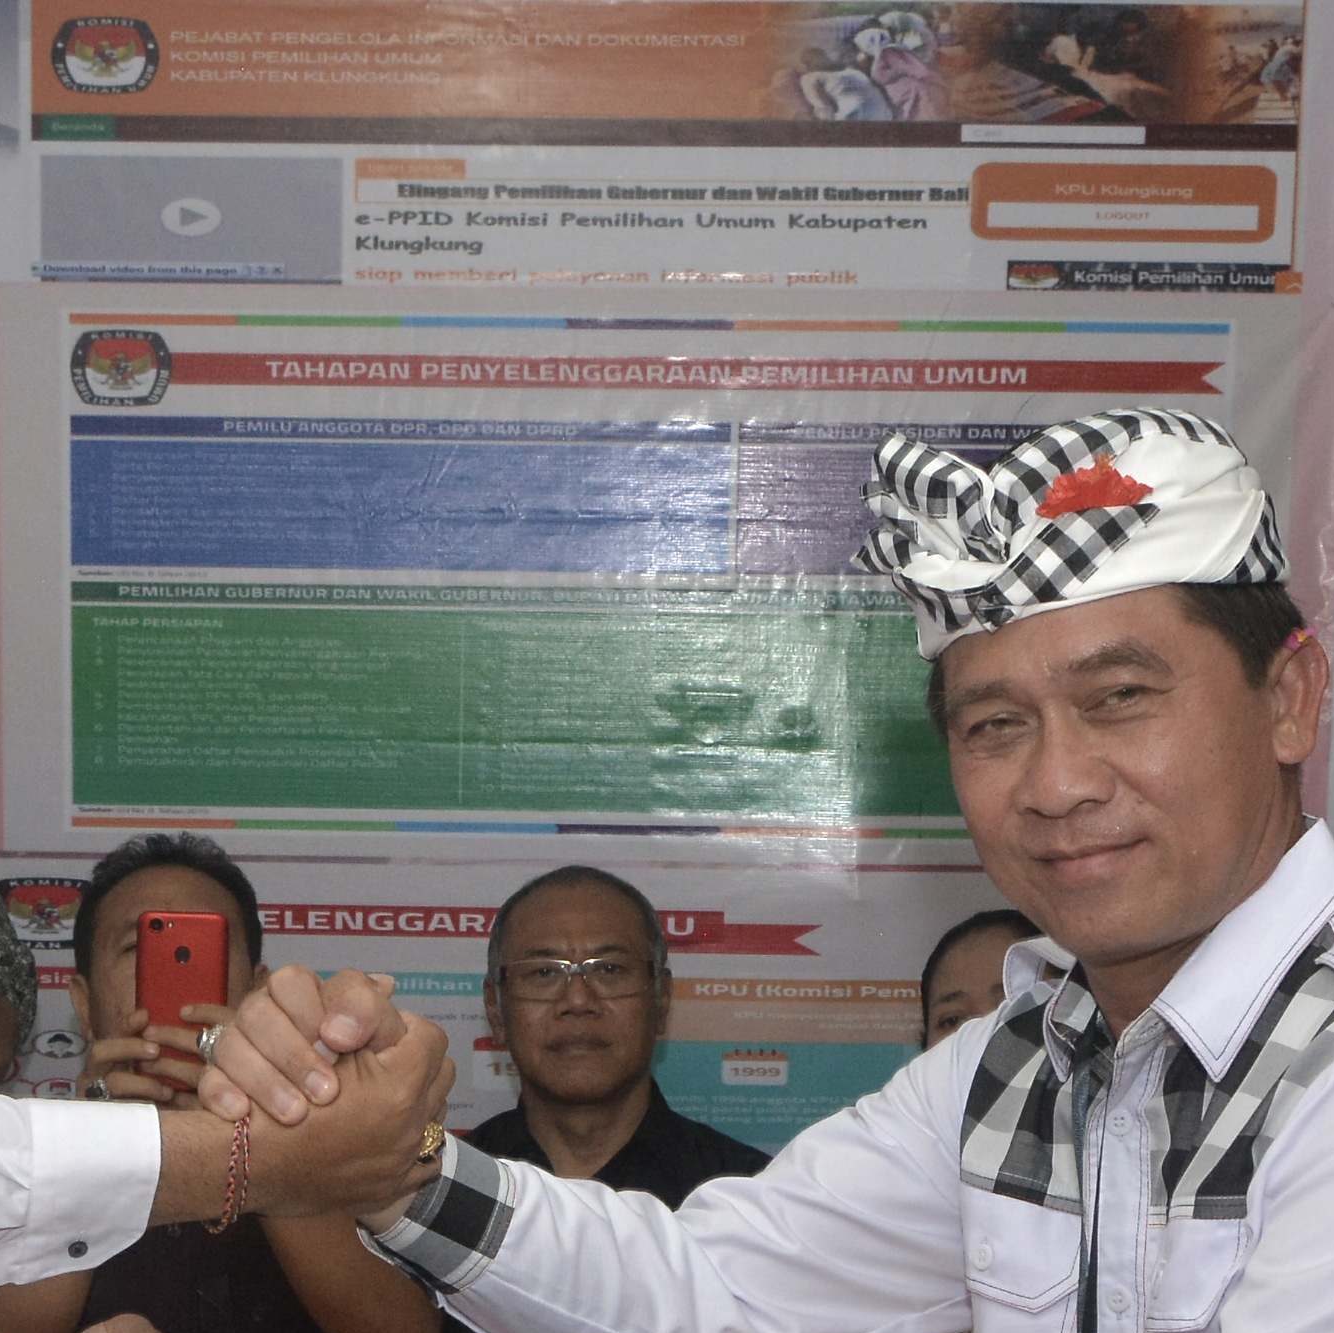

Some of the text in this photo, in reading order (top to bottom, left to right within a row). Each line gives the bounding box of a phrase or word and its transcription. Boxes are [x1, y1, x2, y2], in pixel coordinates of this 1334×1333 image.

[170, 31, 746, 47] PEJABAT PENGELOLA INFORMASI DAN DOKUMENTASI
[170, 51, 442, 65] KOMISI PEMILIHAN UMUM
[170, 70, 441, 84] KABUPATEN KLUNGKUNG
[494, 184, 602, 200] Pemilihan
[607, 185, 708, 201] Gubernur
[712, 186, 753, 201] dan
[756, 186, 819, 201] Wakil
[823, 187, 924, 201] Gubernur
[1056, 184, 1194, 199] KPU Klungkung
[355, 211, 928, 232] e-PPID Komisi Pemilihan Umum Kabupaten
[355, 235, 484, 255] Klungkung
[355, 268, 403, 283] siap
[414, 269, 516, 282] memberi
[787, 270, 859, 286] publik
[1074, 270, 1133, 284] Komisi
[1138, 271, 1225, 285] Pemilihan
[266, 361, 1028, 385] TAHAPAN PENYELENGGARAAN PEMILIHAN UMUM
[223, 419, 293, 433] PEMILU
[298, 420, 385, 434] ANGGOTA
[968, 429, 1005, 440] DAN
[118, 585, 220, 598] PEMILIHAN
[226, 586, 328, 600] GUBERNUR
[333, 587, 371, 600] DAN
[92, 618, 224, 629] TAHAP PERSIAPAN
[695, 983, 852, 999] KPU (Komisi
[730, 1066, 781, 1078] 1999
